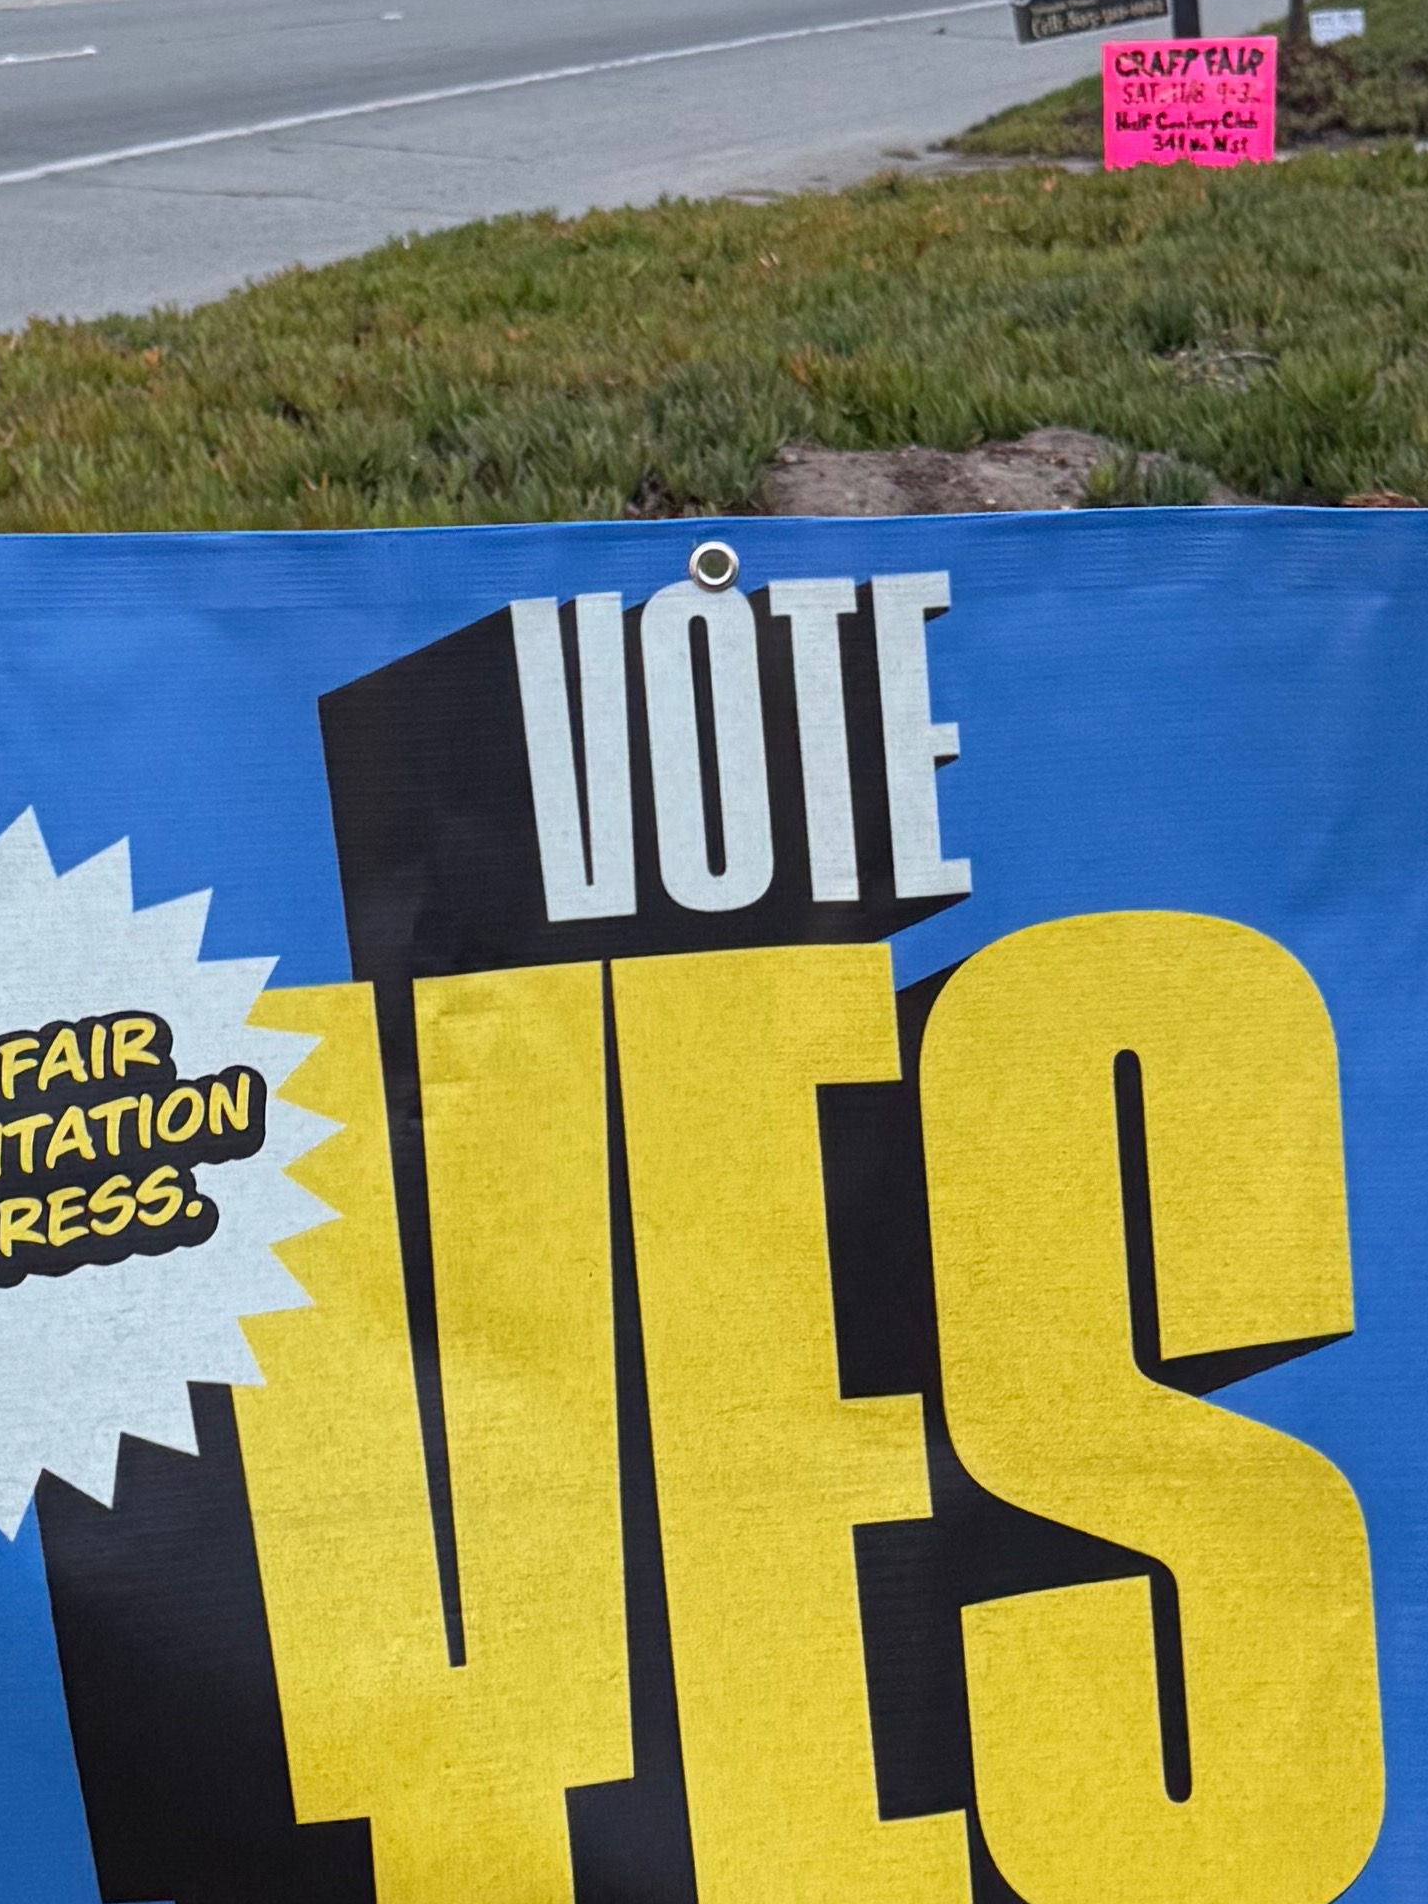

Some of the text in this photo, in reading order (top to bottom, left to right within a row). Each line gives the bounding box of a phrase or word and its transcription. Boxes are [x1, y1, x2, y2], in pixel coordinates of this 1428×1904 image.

[1115, 47, 1264, 77] CRAFT FAIR
[509, 571, 972, 922] VOTE
